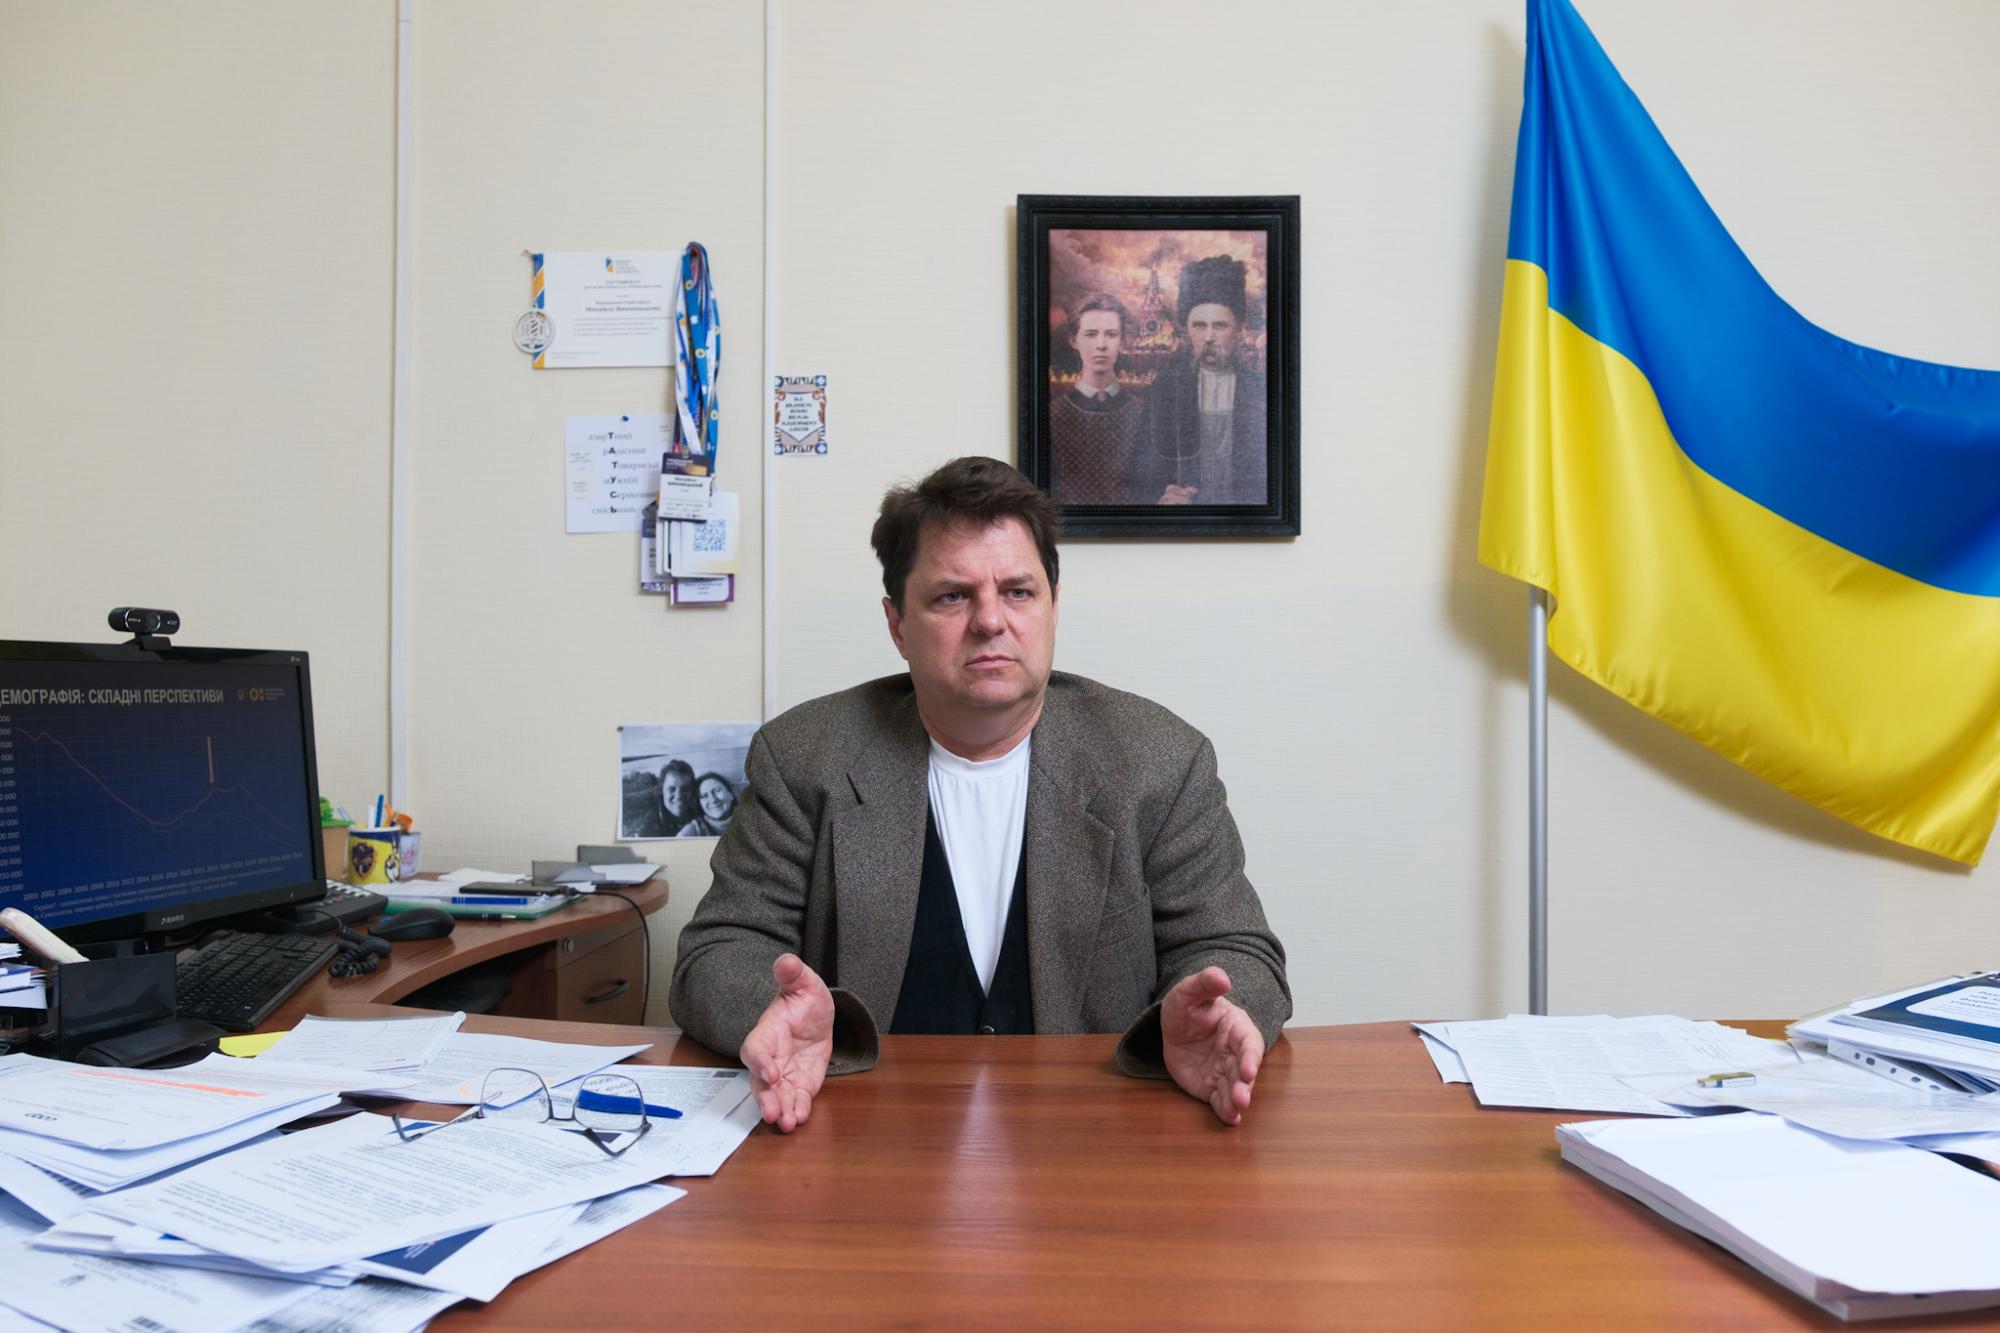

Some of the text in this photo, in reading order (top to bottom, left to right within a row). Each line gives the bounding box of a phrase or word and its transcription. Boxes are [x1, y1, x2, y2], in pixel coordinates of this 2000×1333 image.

[0, 688, 224, 707] ЕМОГРАФІЯ: СКЛАДНІ ПЕРСПЕКТИВИ
